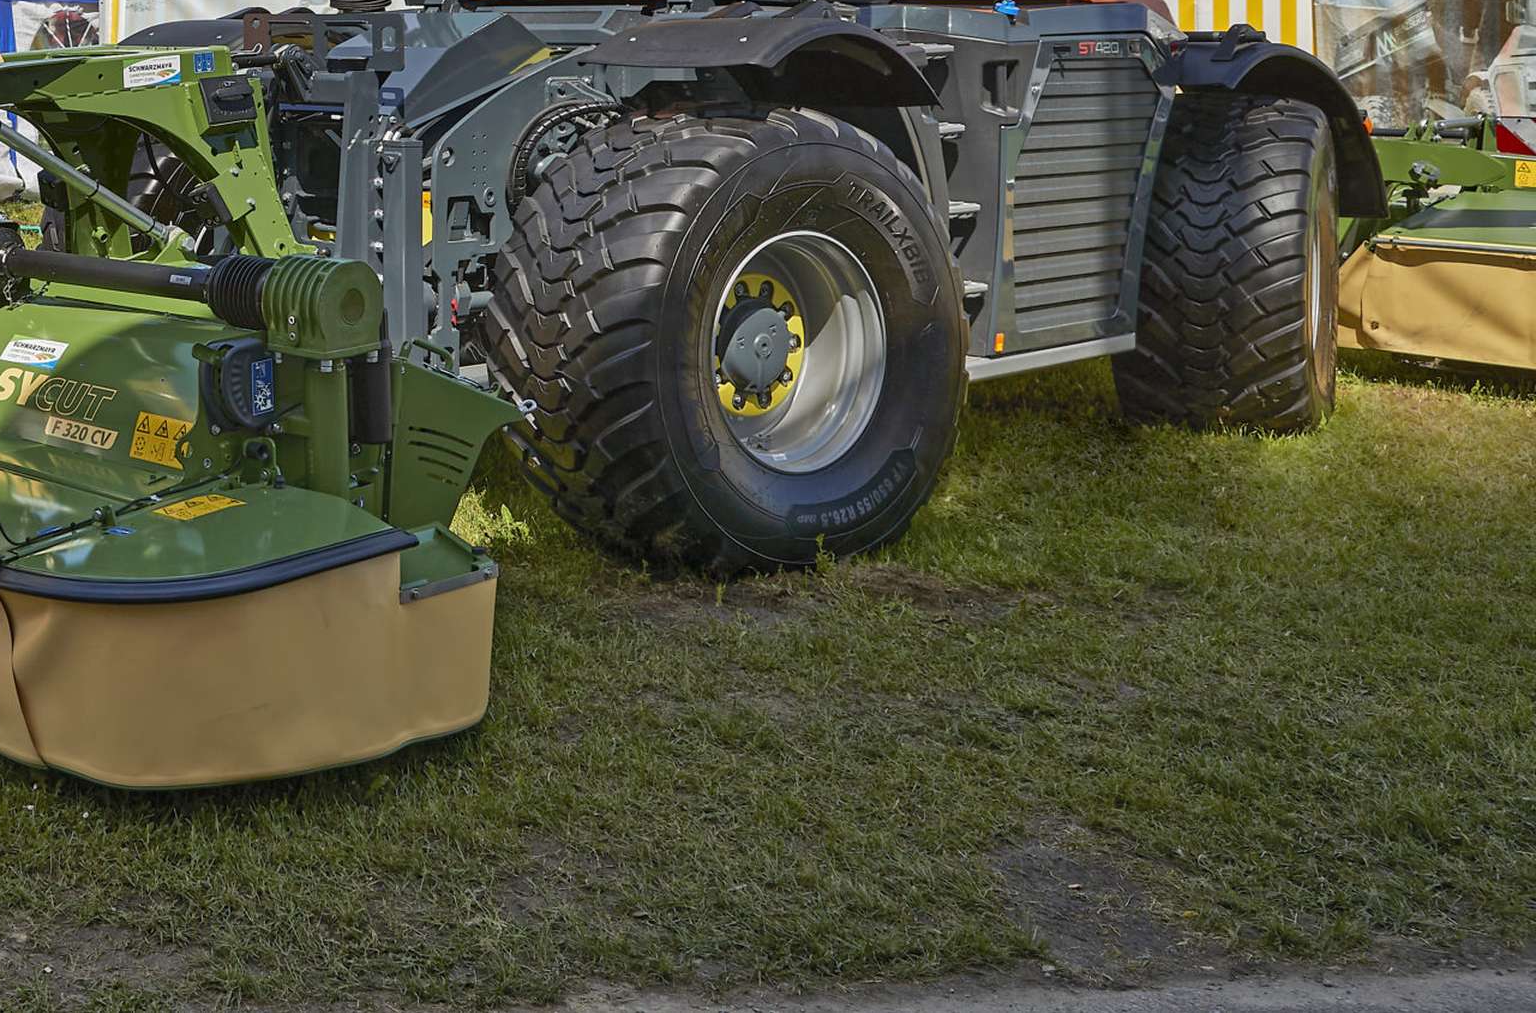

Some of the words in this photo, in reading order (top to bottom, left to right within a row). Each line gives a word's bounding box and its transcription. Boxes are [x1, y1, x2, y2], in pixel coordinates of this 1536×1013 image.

[1078, 41, 1120, 55] ST420
[51, 422, 63, 435] F
[62, 423, 89, 441] 320
[90, 429, 112, 447] CV
